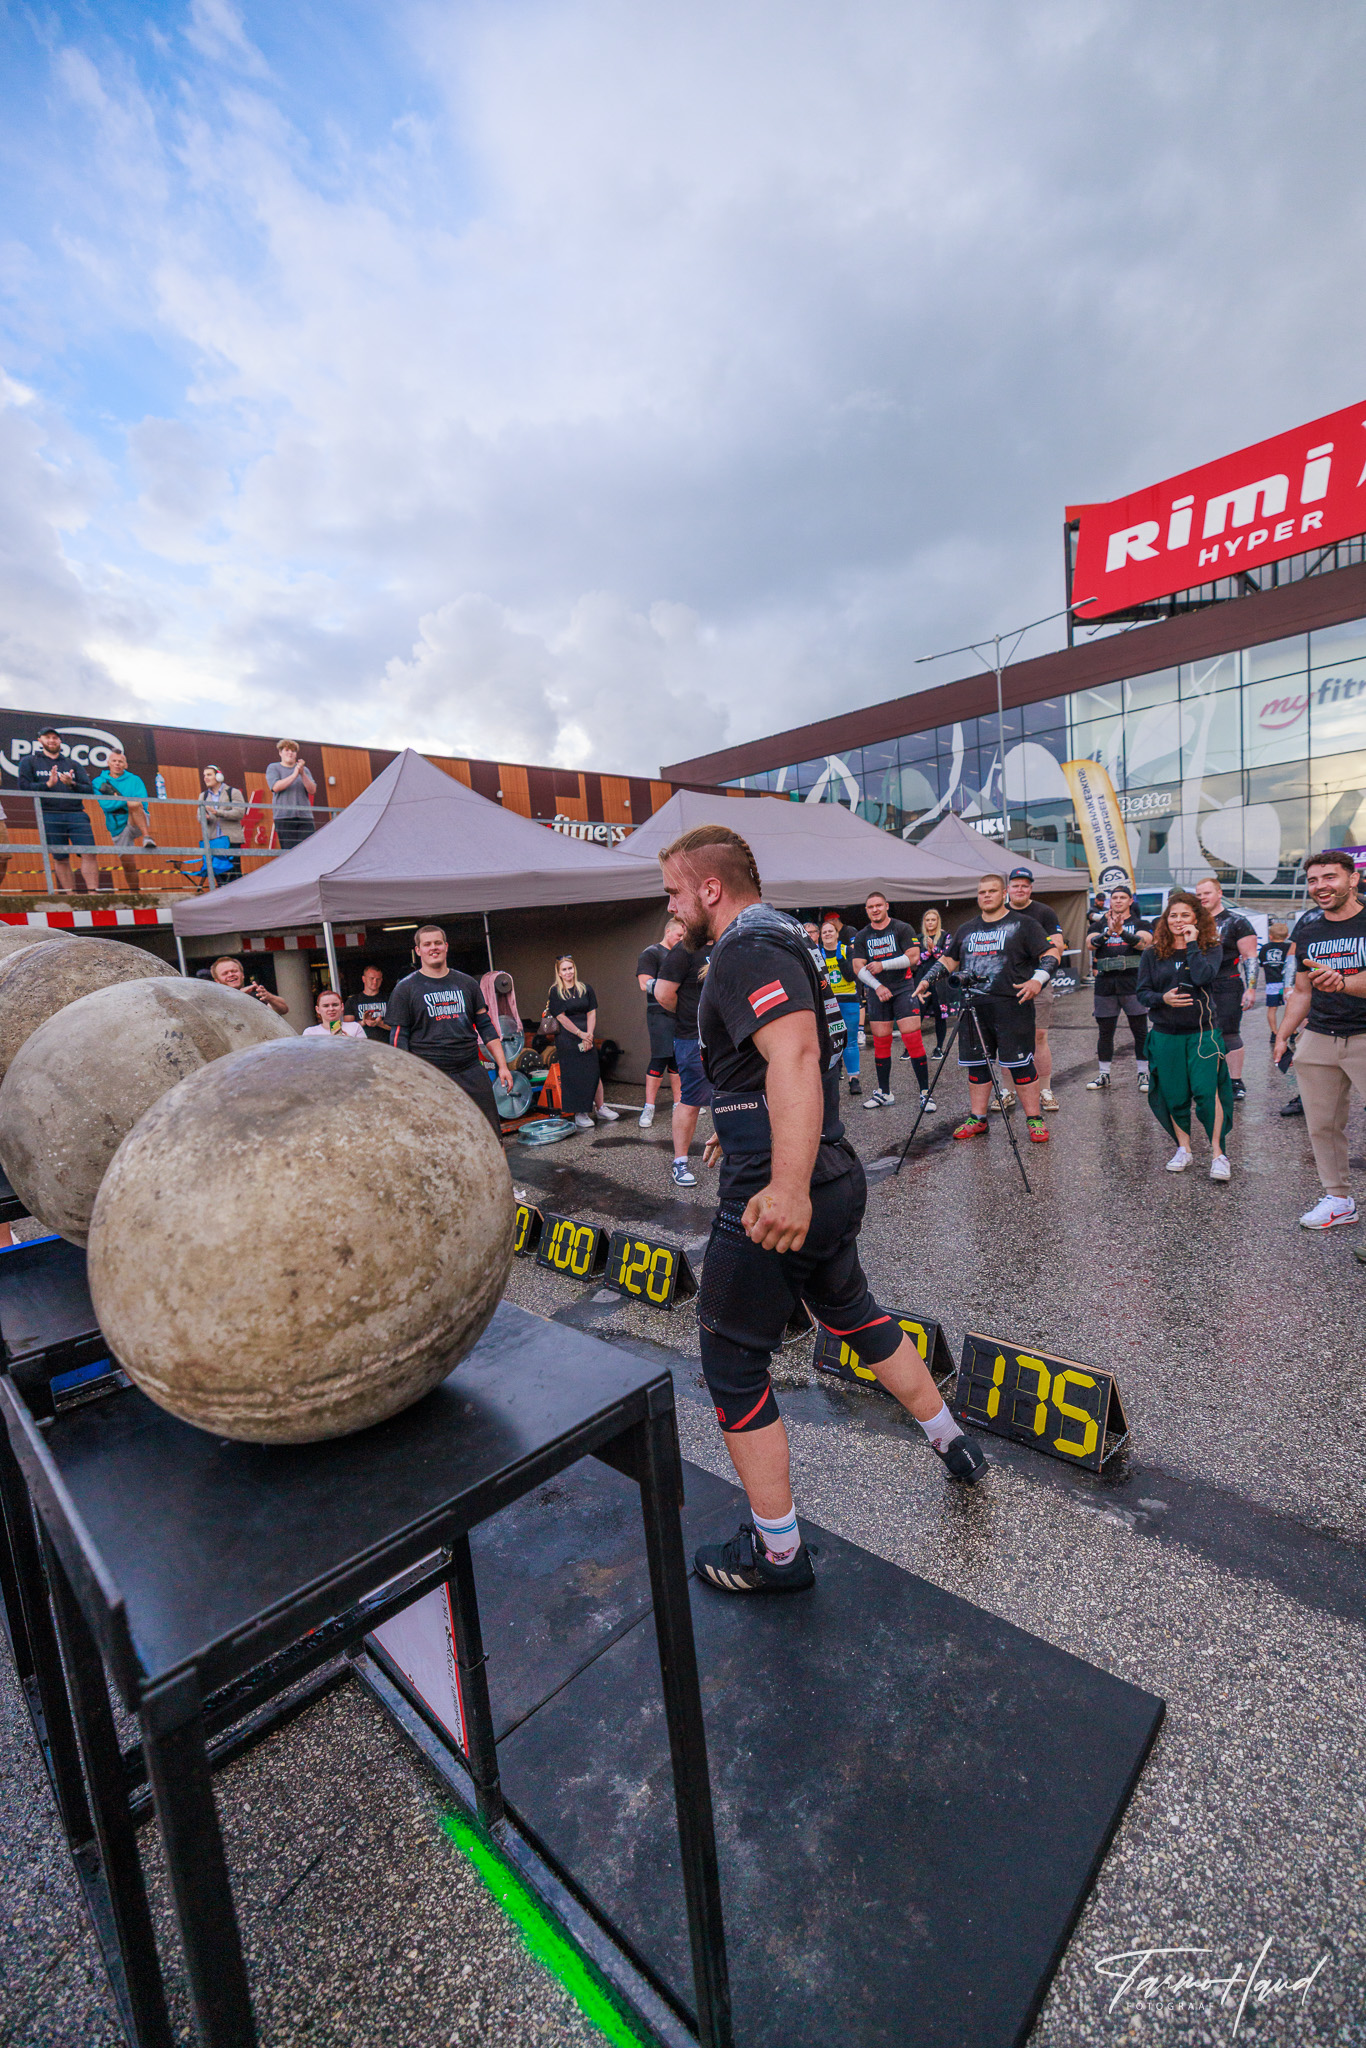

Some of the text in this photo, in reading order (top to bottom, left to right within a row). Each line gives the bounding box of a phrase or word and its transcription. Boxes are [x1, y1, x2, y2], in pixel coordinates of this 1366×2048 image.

[1198, 510, 1324, 567] HYPER
[1118, 792, 1172, 813] Betta
[1307, 937, 1366, 958] STRONGMAN
[547, 1220, 595, 1276] 100
[618, 1241, 674, 1303] 120
[986, 1353, 1099, 1458] 175
